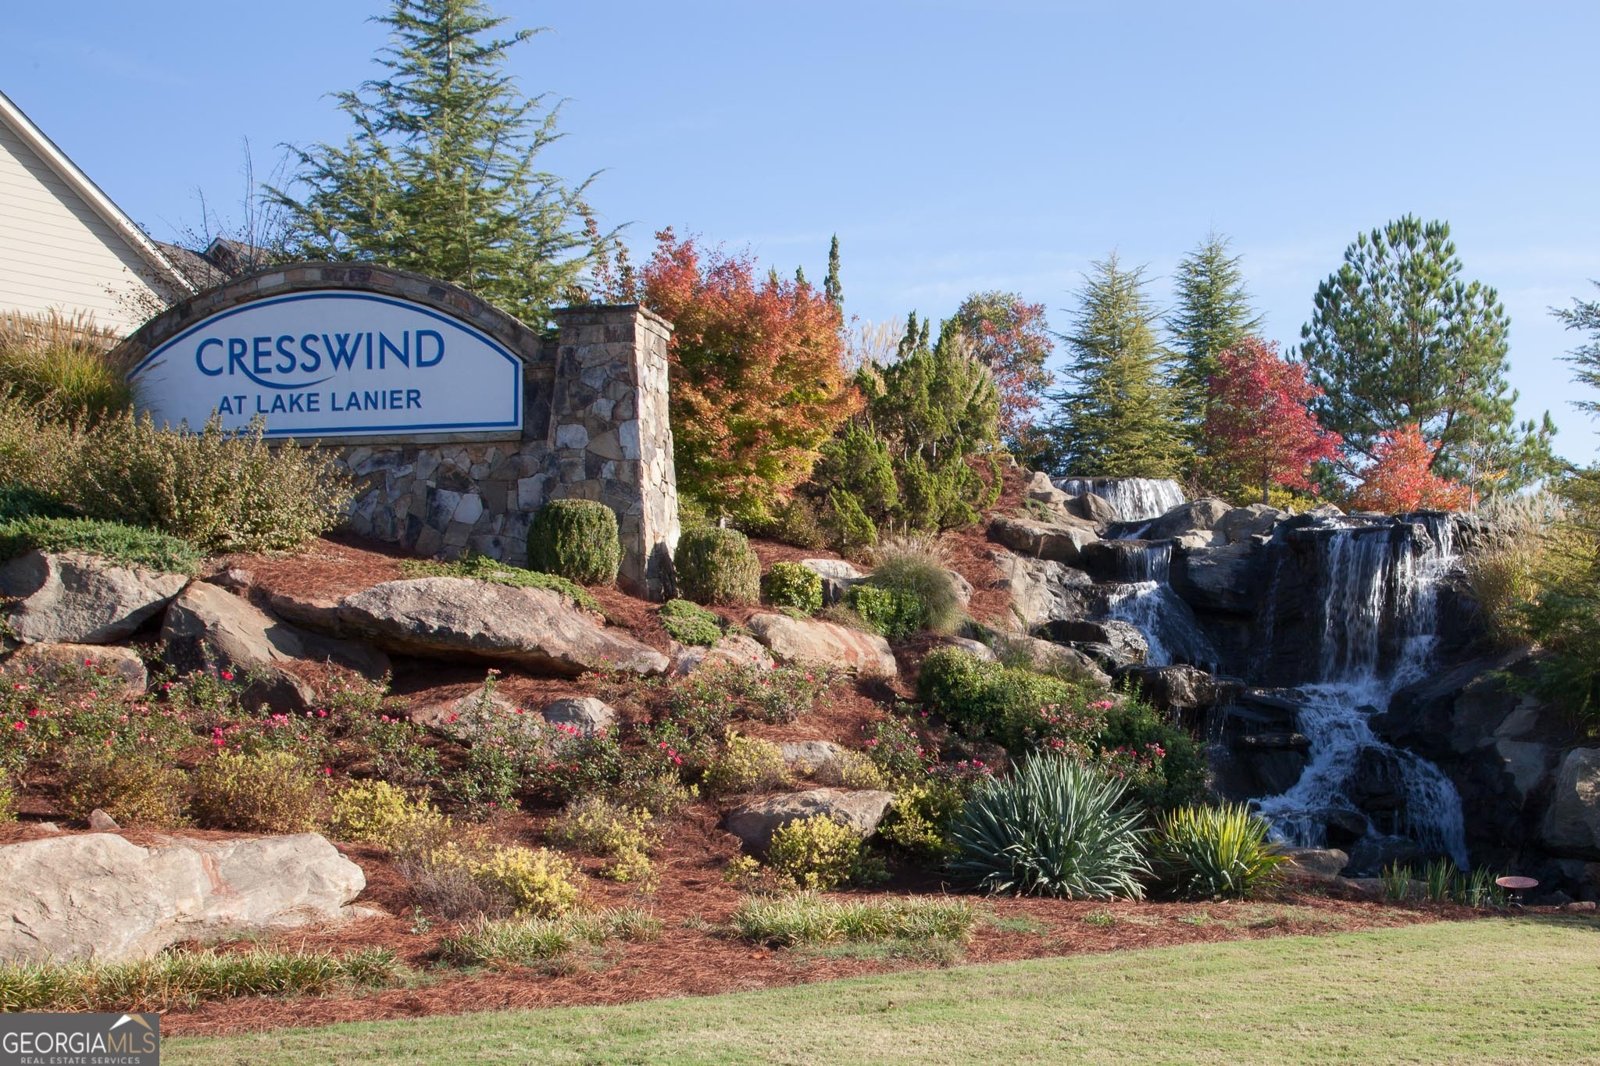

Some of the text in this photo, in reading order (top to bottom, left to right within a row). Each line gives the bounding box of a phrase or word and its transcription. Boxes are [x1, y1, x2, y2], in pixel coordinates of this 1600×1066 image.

[195, 329, 446, 389] CRESSWIND
[218, 389, 422, 416] AT LAKE LANIER
